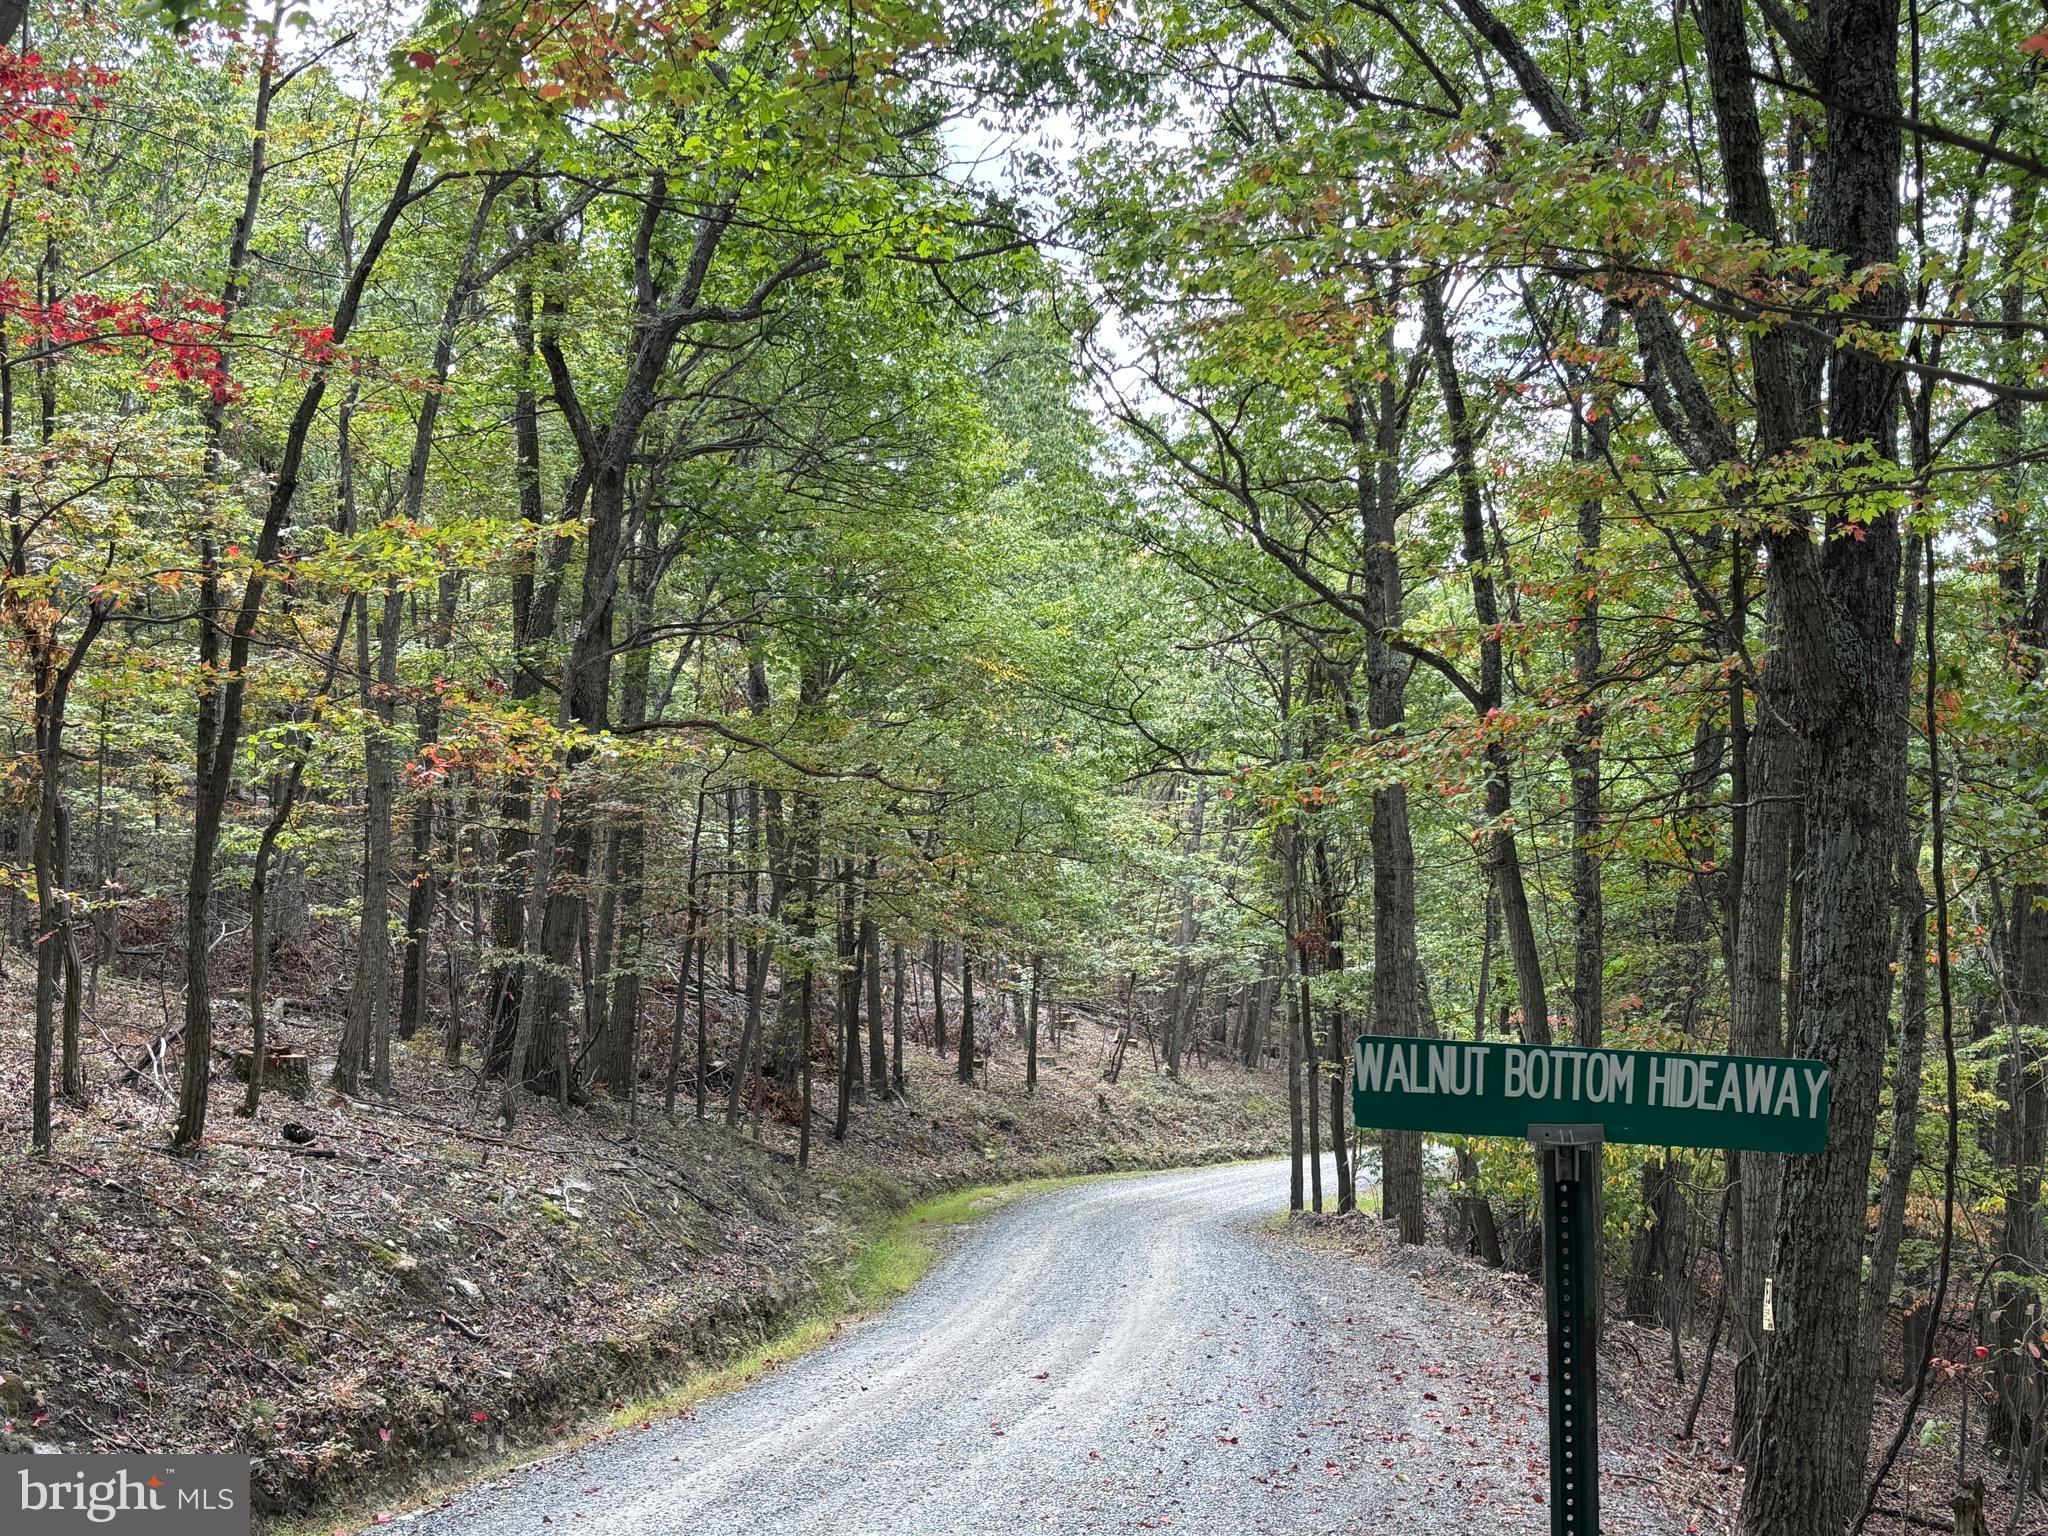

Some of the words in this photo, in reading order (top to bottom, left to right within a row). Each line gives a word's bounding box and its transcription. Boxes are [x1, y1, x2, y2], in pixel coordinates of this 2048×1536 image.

[1355, 1042, 1490, 1096] WALNUT
[1505, 1048, 1635, 1104] BOTTOM
[1648, 1057, 1829, 1119] HIDEAWAY
